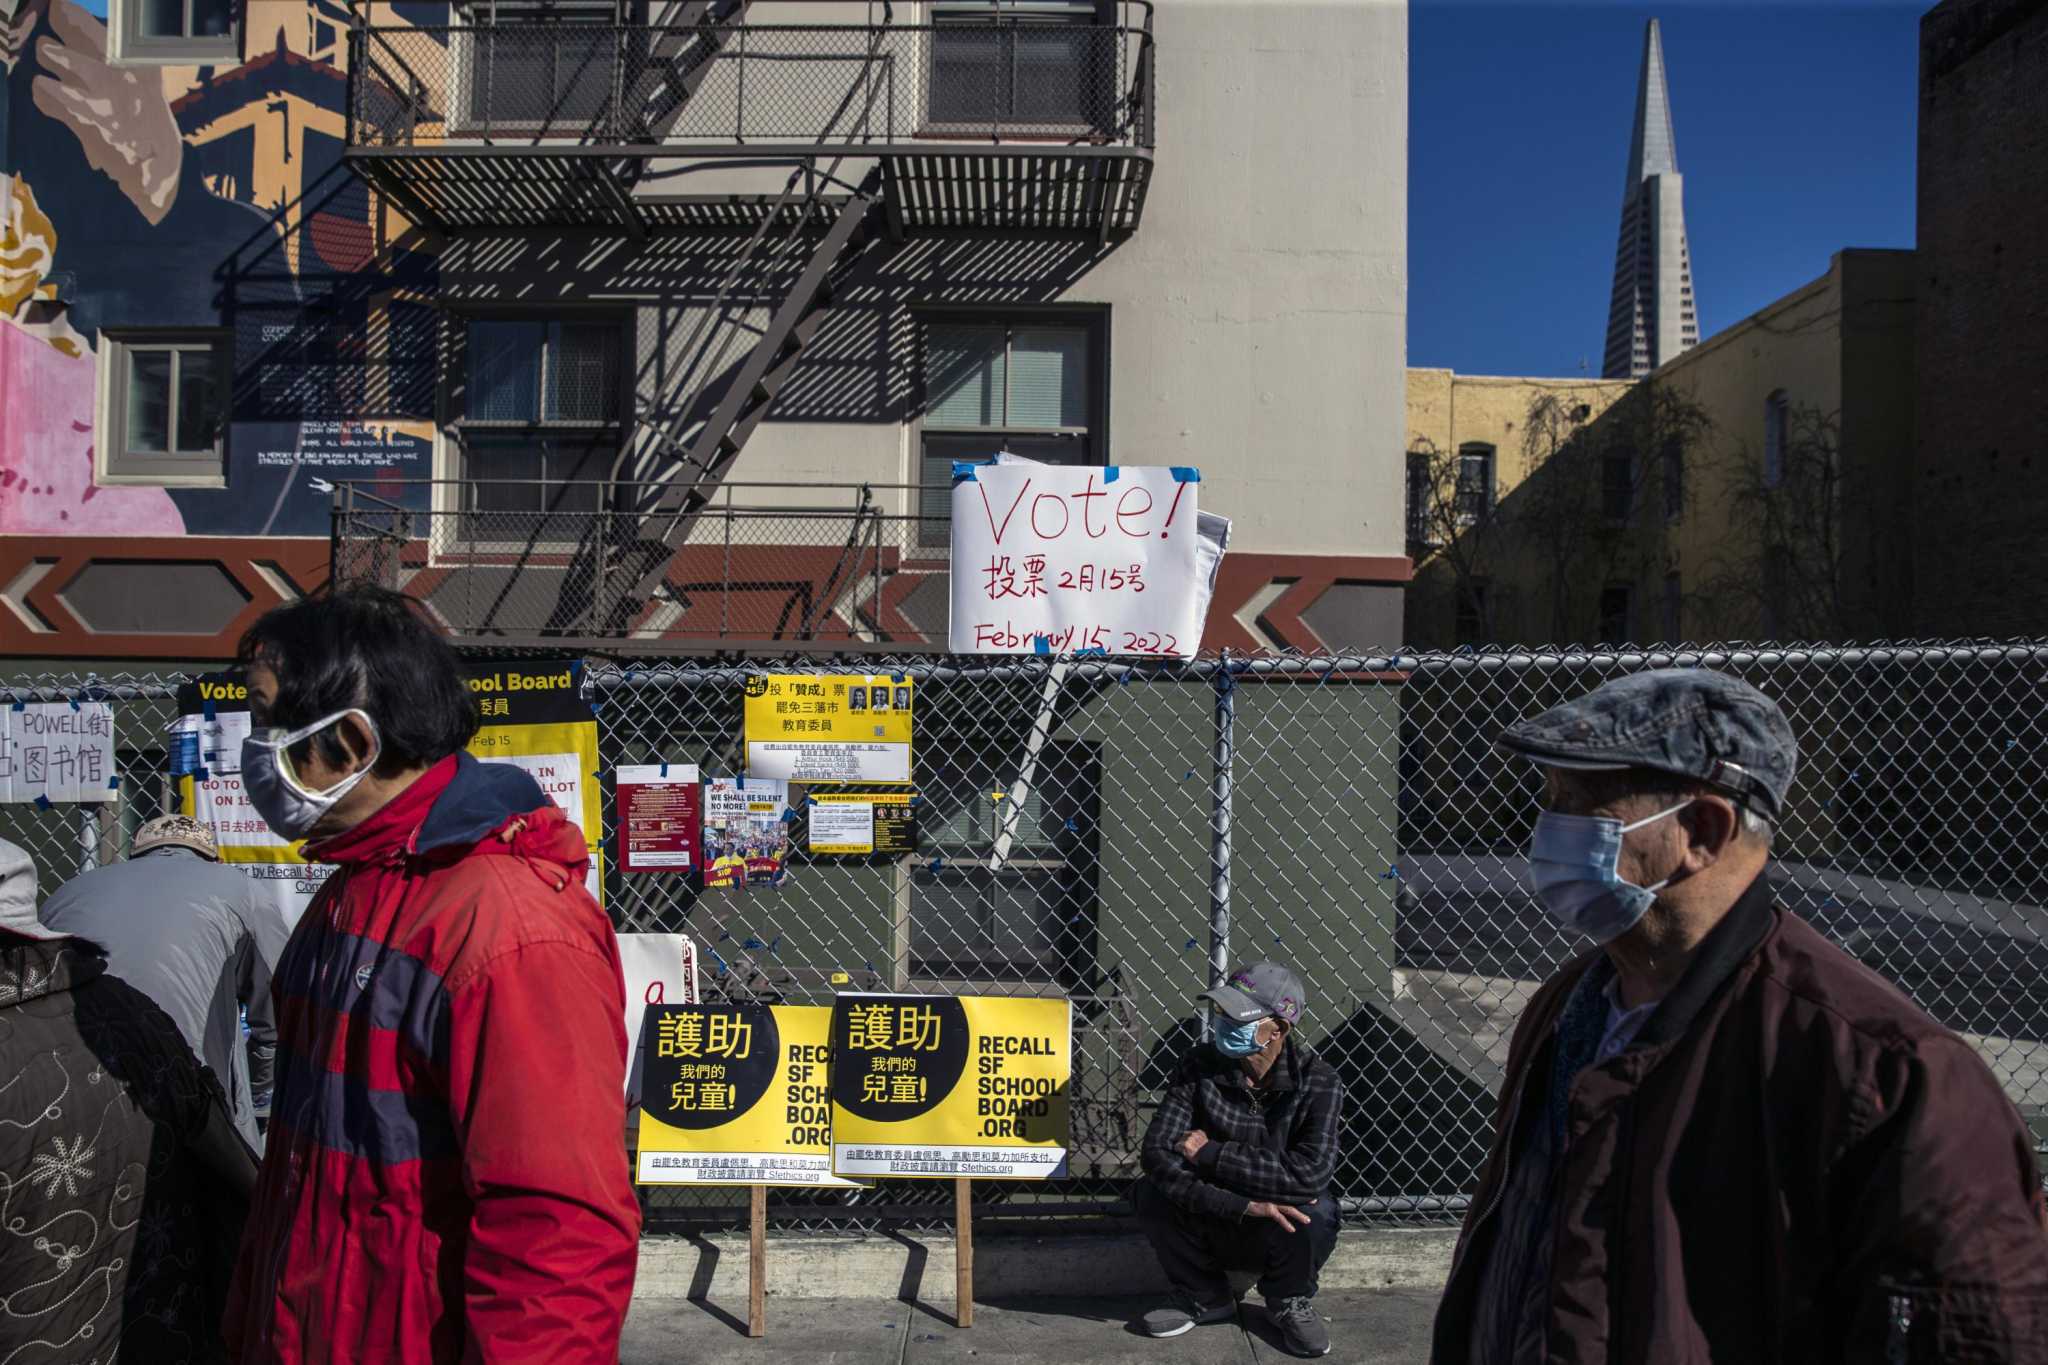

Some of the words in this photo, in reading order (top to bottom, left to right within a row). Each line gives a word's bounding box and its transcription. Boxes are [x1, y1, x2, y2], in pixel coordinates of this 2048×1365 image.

[979, 474, 1186, 545] Vote!
[982, 554, 1048, 600] 投票
[1122, 631, 1181, 655] 2022
[507, 670, 572, 691] Board
[199, 683, 248, 699] Vote
[776, 701, 839, 714] 罷免三藩市
[782, 719, 832, 732] 教育委員
[473, 736, 496, 746] Feb
[498, 735, 511, 745] 15
[24, 743, 103, 786] 图书馆
[538, 767, 555, 777] IN
[201, 780, 220, 790] GO
[222, 780, 240, 790] TO
[215, 796, 234, 806] ON
[711, 794, 722, 802] WE
[724, 794, 745, 802] SHALL
[252, 866, 265, 879] by
[267, 865, 302, 877] Recall
[657, 1012, 752, 1059] 護助
[848, 1004, 942, 1051] 護助
[978, 1035, 1056, 1056] RECALL
[680, 1064, 726, 1080] 我們的
[787, 1064, 814, 1083] SF
[871, 1056, 917, 1072] 我們的
[978, 1056, 1004, 1075] SF
[787, 1085, 830, 1105] SCH
[978, 1077, 1062, 1096] SCHOOL
[786, 1105, 829, 1126] BOA
[978, 1098, 1049, 1117] BOARD
[785, 1126, 831, 1146] .ORG
[977, 1119, 1027, 1138] .ORG
[768, 1171, 820, 1182] Sfethics.org
[961, 1163, 1013, 1174] Sfethics.org
